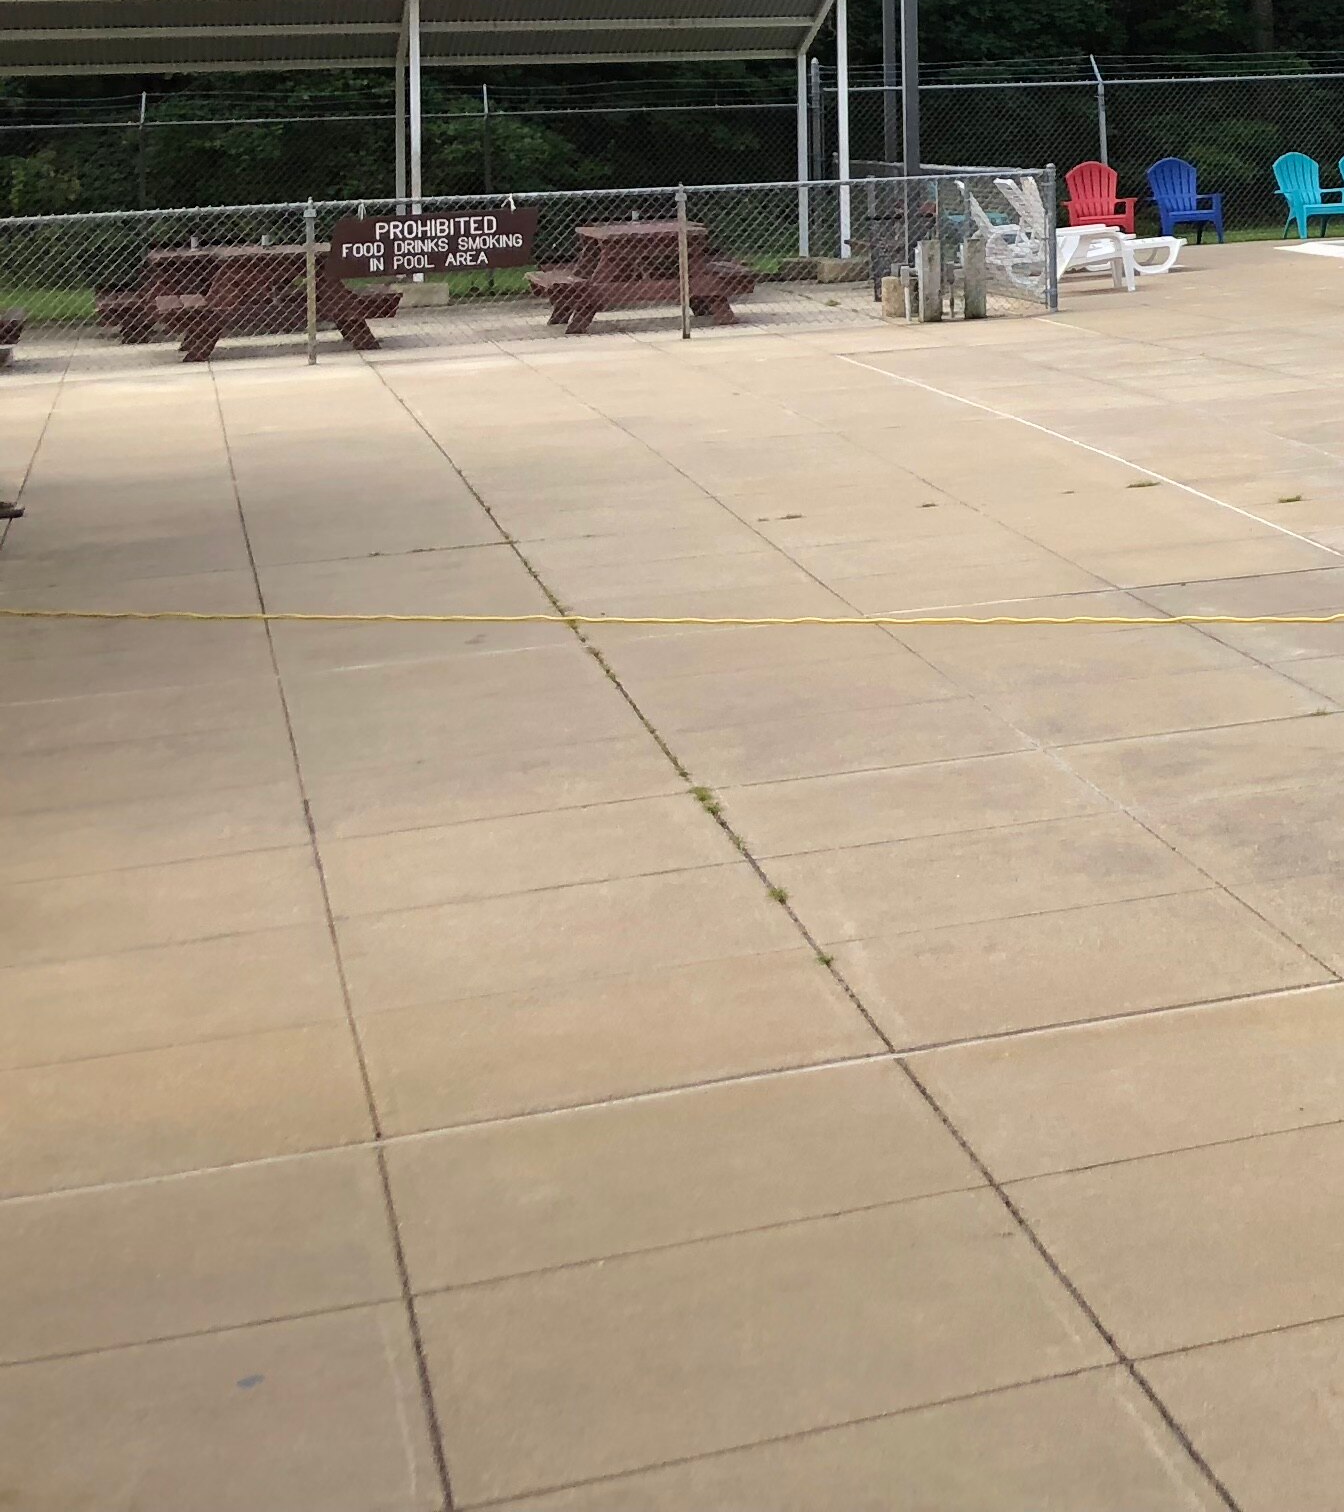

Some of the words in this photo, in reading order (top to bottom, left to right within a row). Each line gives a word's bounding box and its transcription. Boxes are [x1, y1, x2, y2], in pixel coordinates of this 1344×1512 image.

[375, 215, 497, 240] PROHIBITED
[342, 242, 385, 258] FOOD
[394, 238, 449, 254] DRINKS
[458, 233, 523, 250] SMOKING
[369, 257, 385, 272] IN
[393, 254, 435, 270] POOL
[444, 251, 489, 267] AREA
